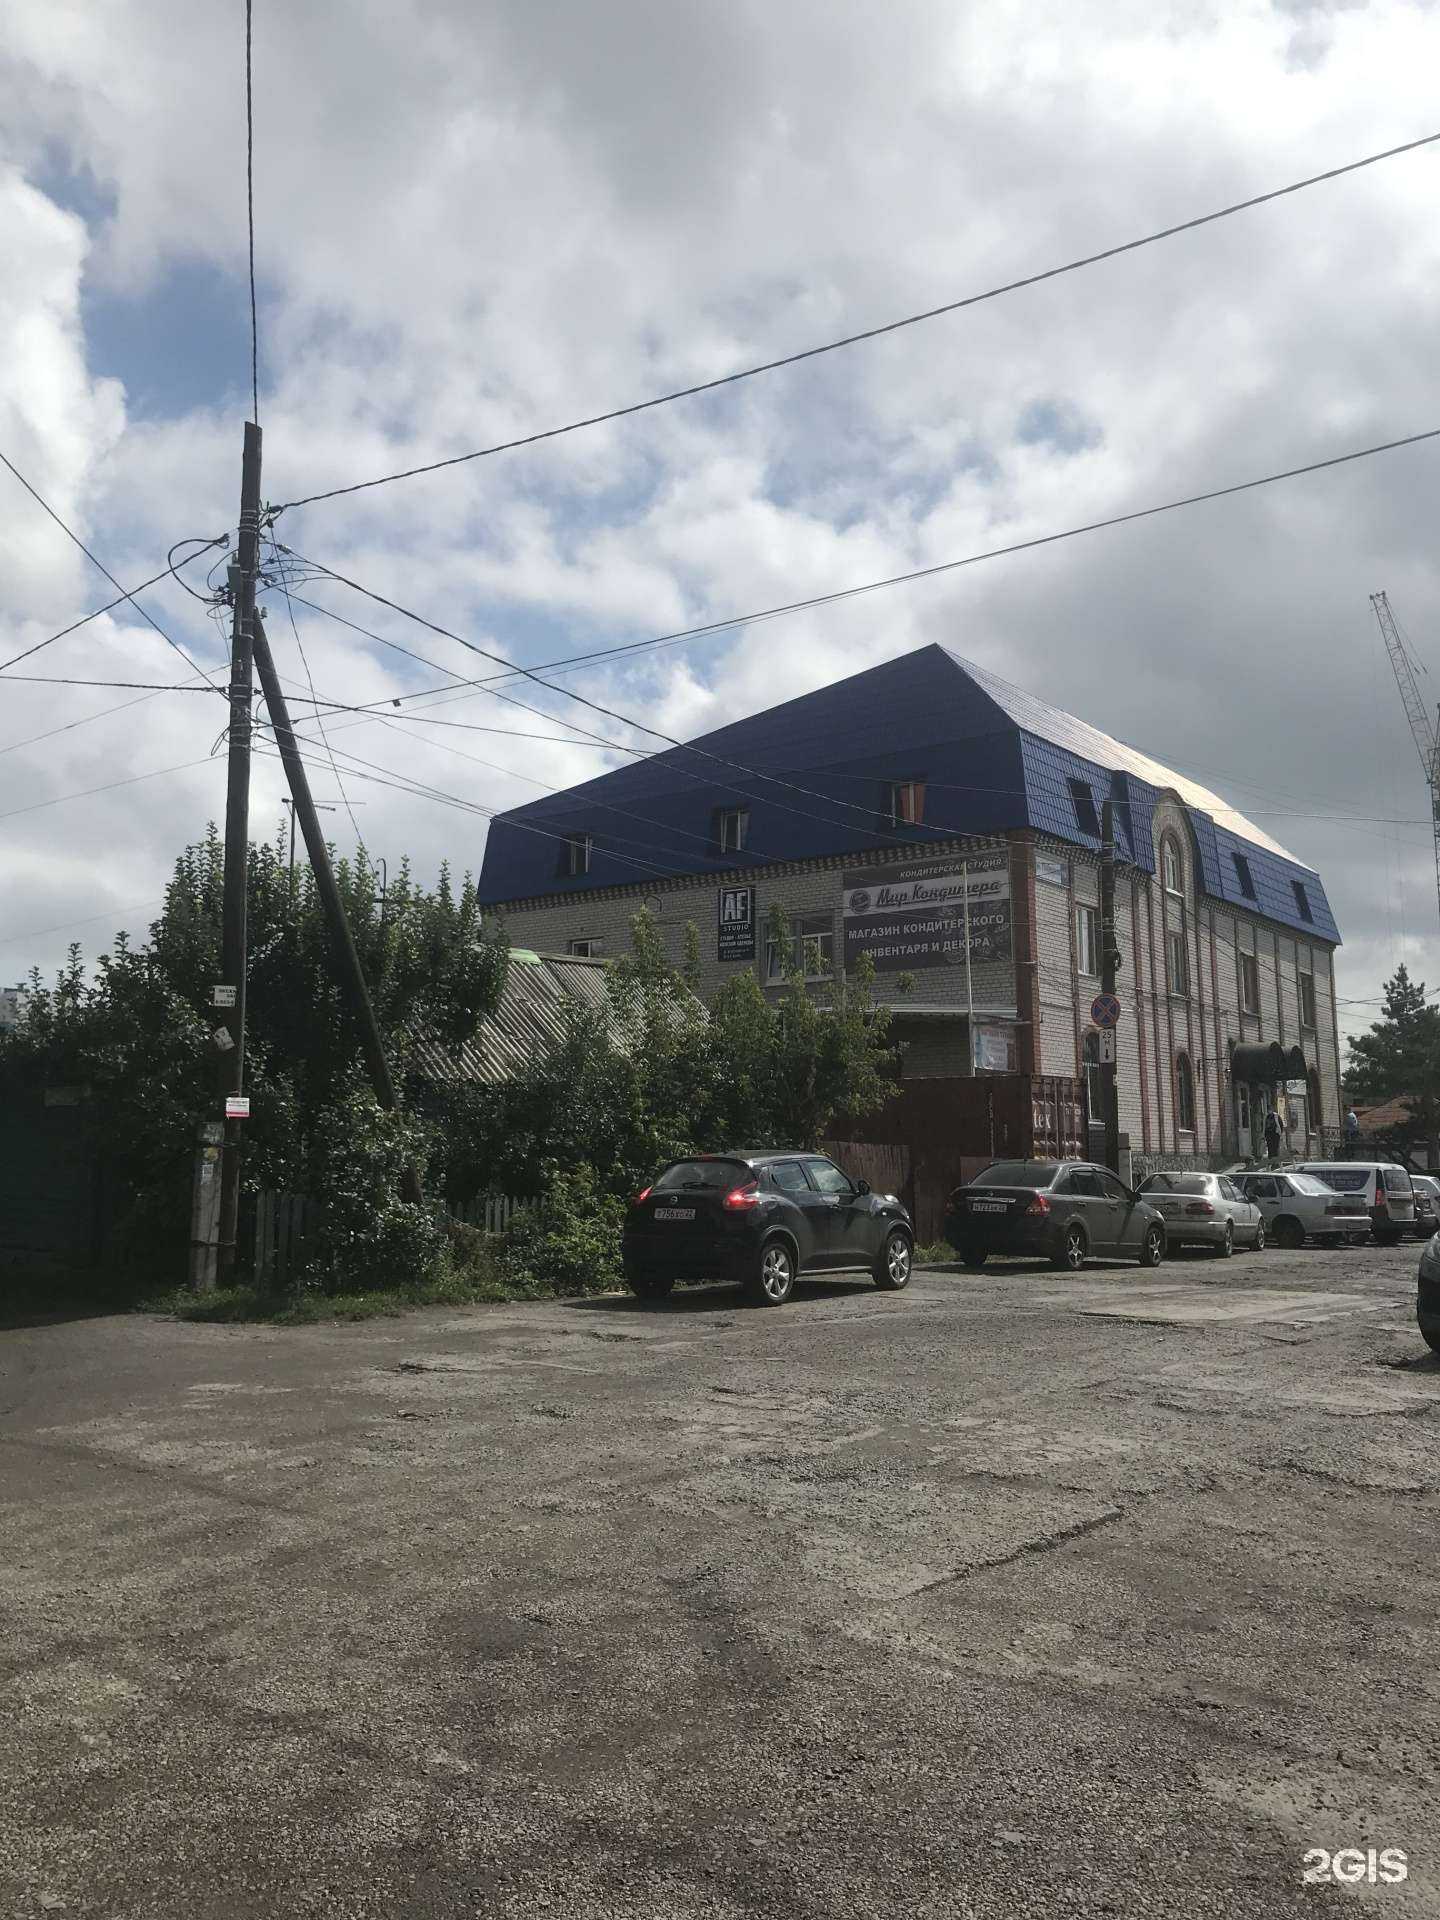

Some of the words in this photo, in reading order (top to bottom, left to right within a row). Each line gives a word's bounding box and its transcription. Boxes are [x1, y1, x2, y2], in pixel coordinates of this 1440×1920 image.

[877, 887, 907, 907] Мир
[721, 924, 749, 933] STUDIO
[848, 925, 901, 940] МАГАЗИН
[862, 943, 929, 958] ИНВЕНТАРЯ
[931, 942, 940, 952] И
[942, 937, 990, 953] ДЕКОРА
[1102, 1031, 1112, 1039] 25
